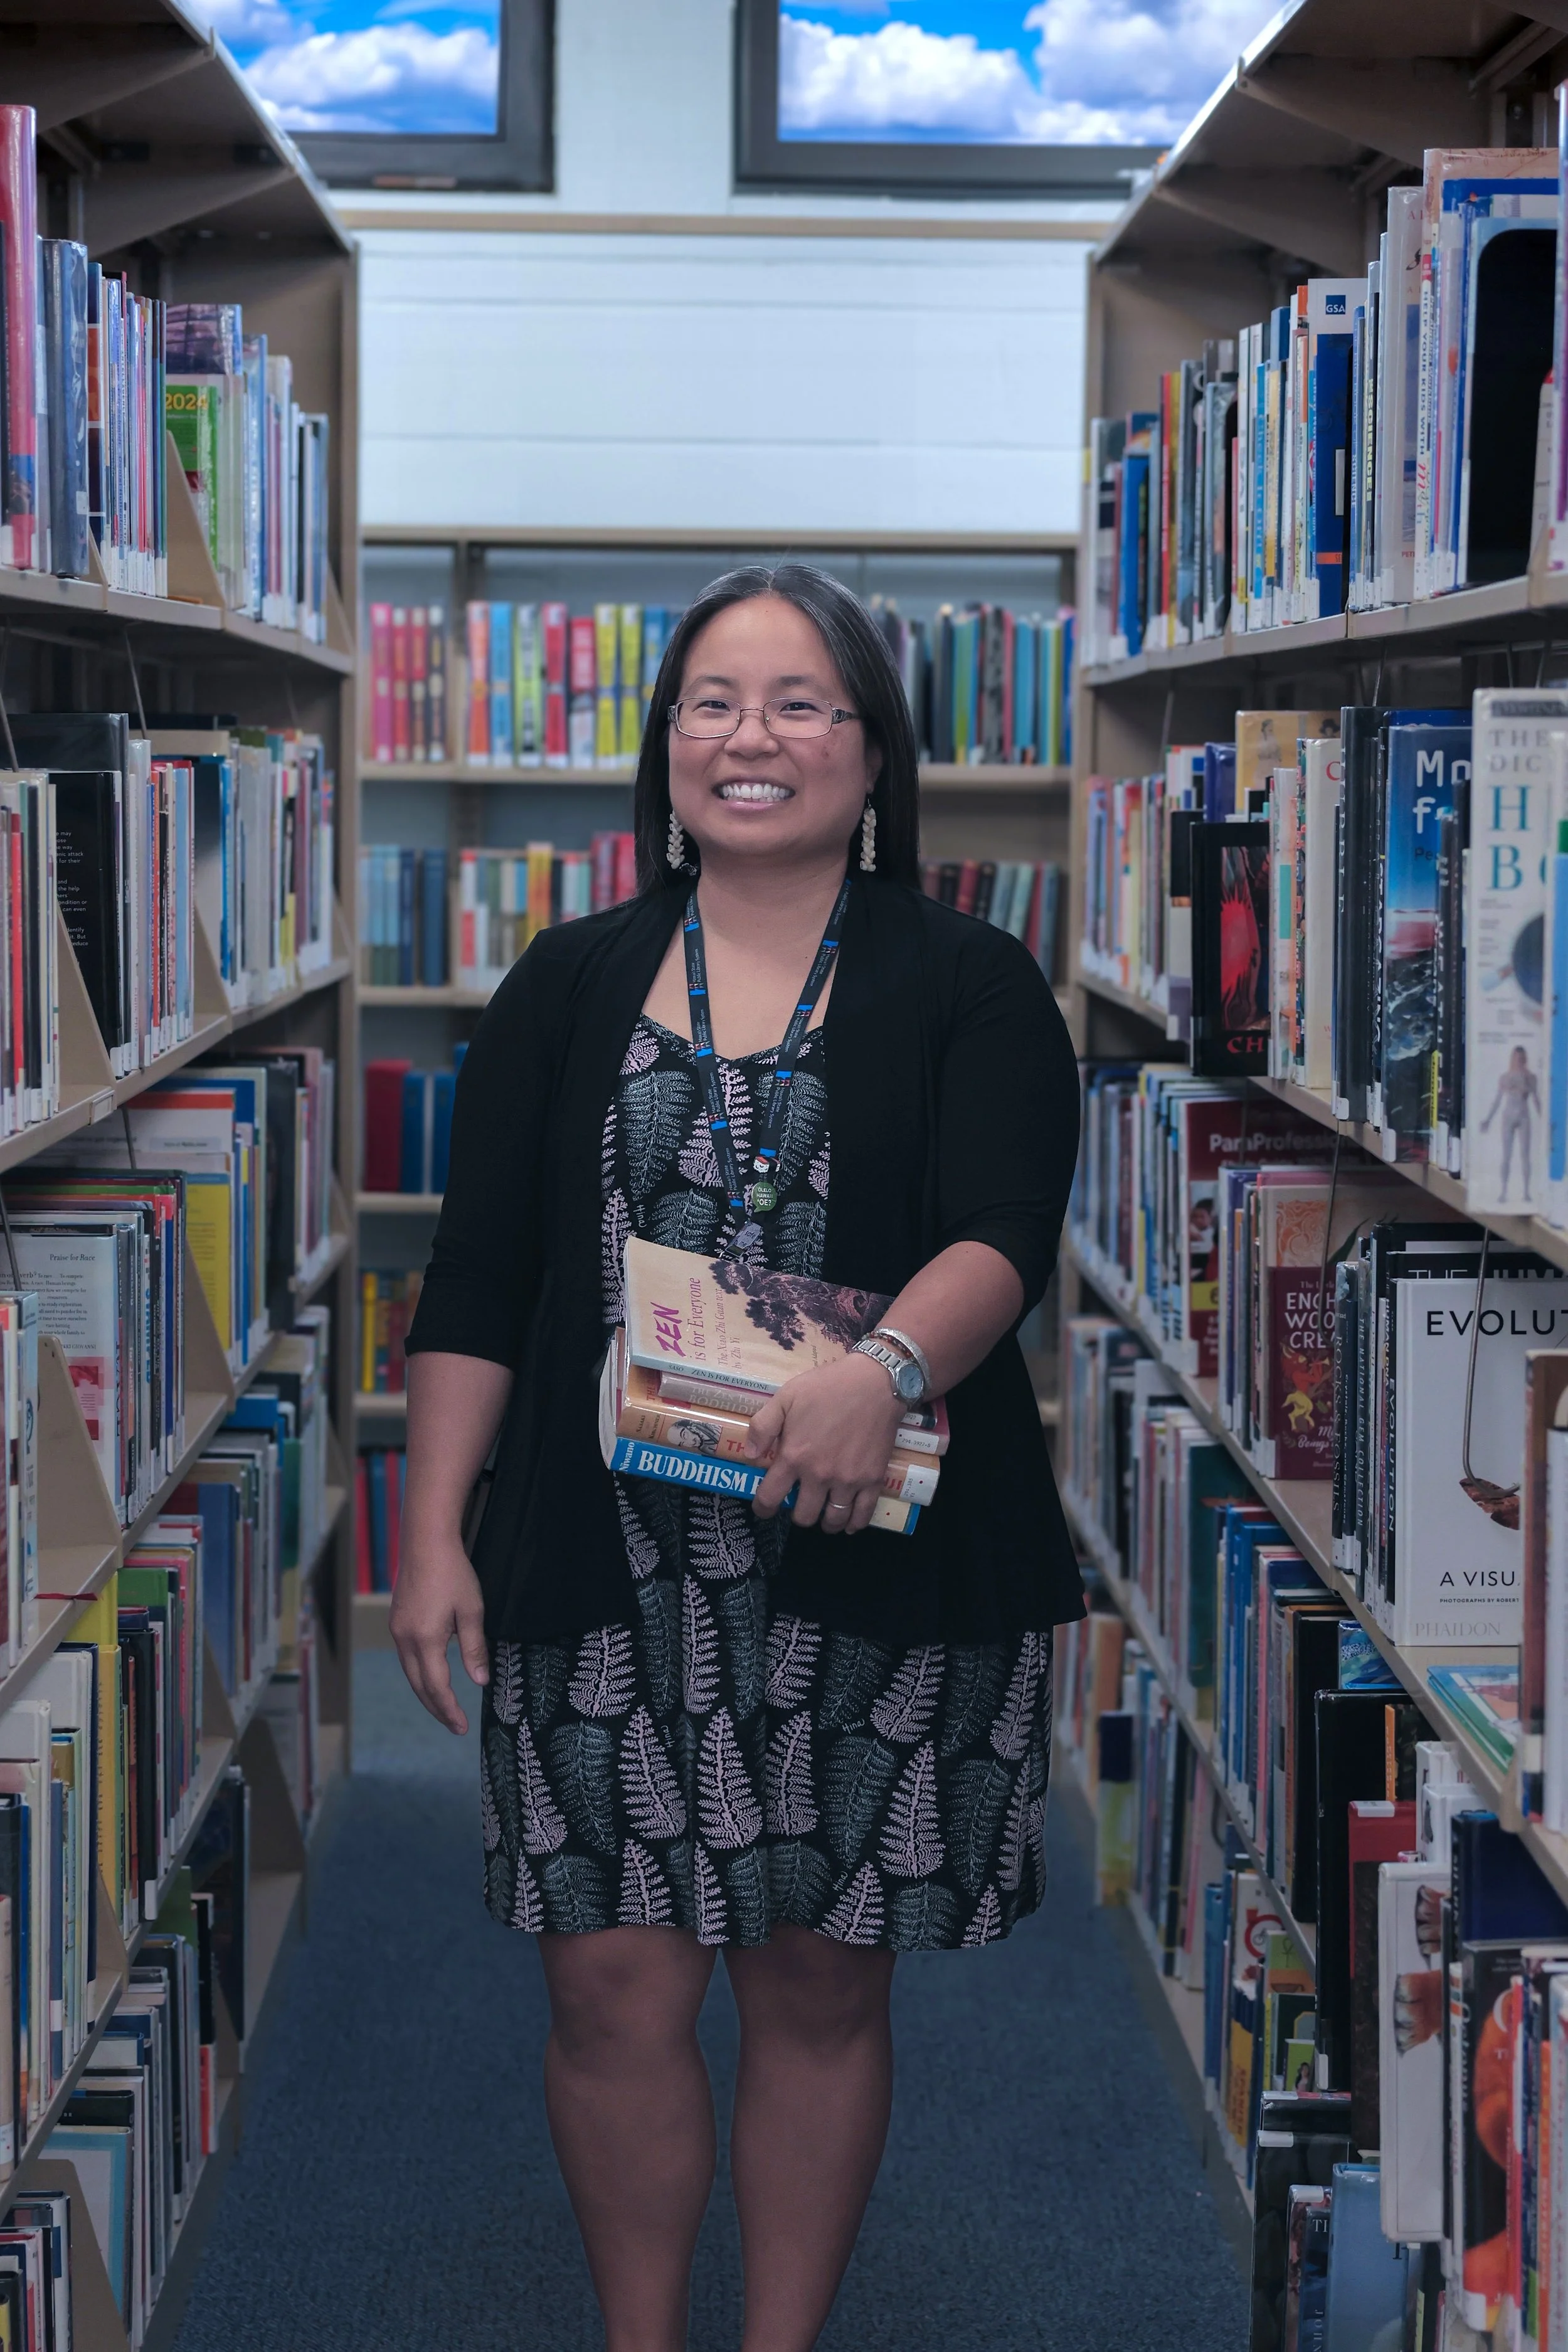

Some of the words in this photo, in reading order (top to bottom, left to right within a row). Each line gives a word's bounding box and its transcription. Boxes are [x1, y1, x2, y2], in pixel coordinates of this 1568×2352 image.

[1326, 304, 1345, 314] GSA
[1489, 729, 1549, 746] THE
[1490, 754, 1542, 772] DIC
[1487, 844, 1547, 891] B
[1227, 1037, 1264, 1054] CH
[633, 1204, 647, 1228] Hina
[744, 1229, 755, 1239] safe
[715, 1288, 723, 1301] text
[687, 1277, 707, 1329] Everyone
[715, 1301, 725, 1320] Guan
[650, 1301, 687, 1358] ZEN
[715, 1321, 726, 1334] Zhi
[687, 1330, 706, 1348] for
[717, 1335, 727, 1350] Xiao
[690, 1352, 706, 1361] is
[718, 1352, 728, 1366] The
[731, 1347, 741, 1359] Zhi
[731, 1360, 742, 1370] by
[1334, 1336, 1342, 1403] ROCKS
[692, 1369, 707, 1377] ZEN
[716, 1374, 730, 1383] FOR
[731, 1377, 770, 1391] EVERYONE
[713, 1389, 733, 1401] ZEN
[1334, 1413, 1341, 1422] &
[726, 1439, 745, 1453] TH
[619, 1441, 635, 1472] Niwano
[637, 1450, 750, 1492] BUDDHISM
[1439, 1572, 1454, 1586] A
[1463, 1571, 1520, 1586] VISU
[1416, 1622, 1500, 1637] PHAIDON
